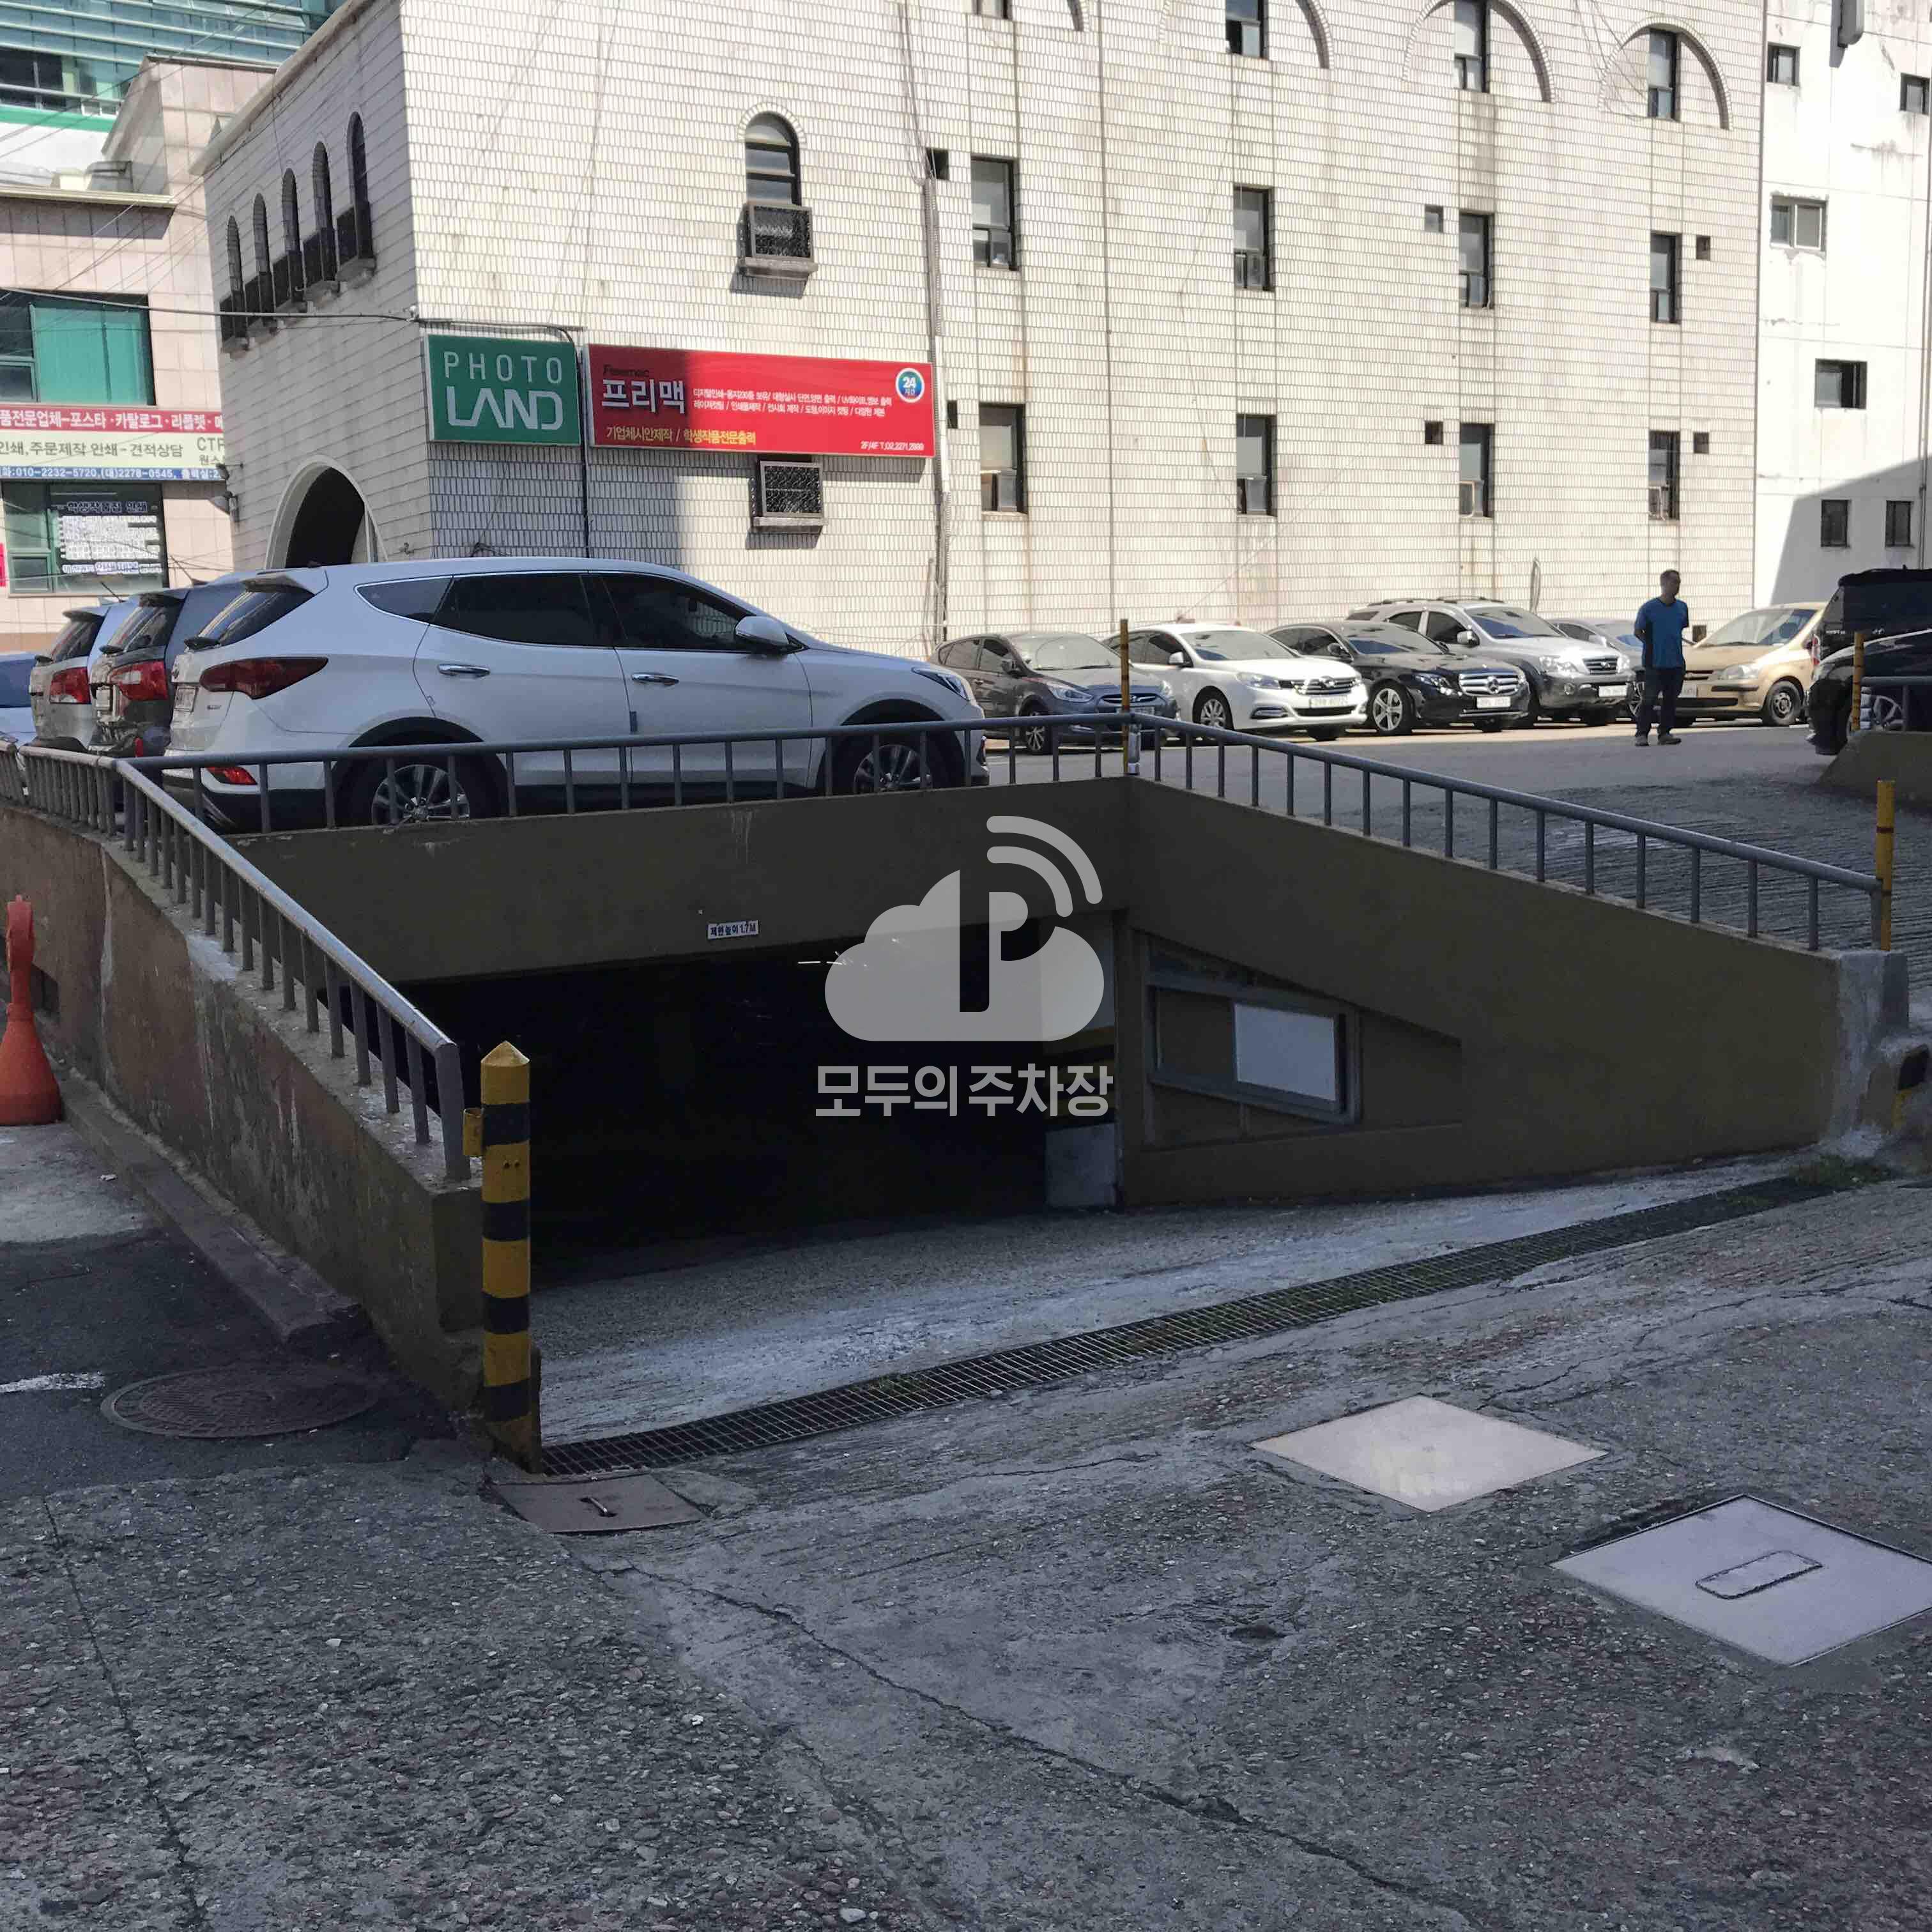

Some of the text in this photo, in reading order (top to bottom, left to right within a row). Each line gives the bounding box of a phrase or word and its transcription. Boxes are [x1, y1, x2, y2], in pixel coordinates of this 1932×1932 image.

[444, 351, 562, 384] PHOTO
[902, 377, 917, 388] 24
[447, 386, 564, 431] LAND
[602, 378, 684, 414] 프리맥
[199, 454, 225, 466] 원스
